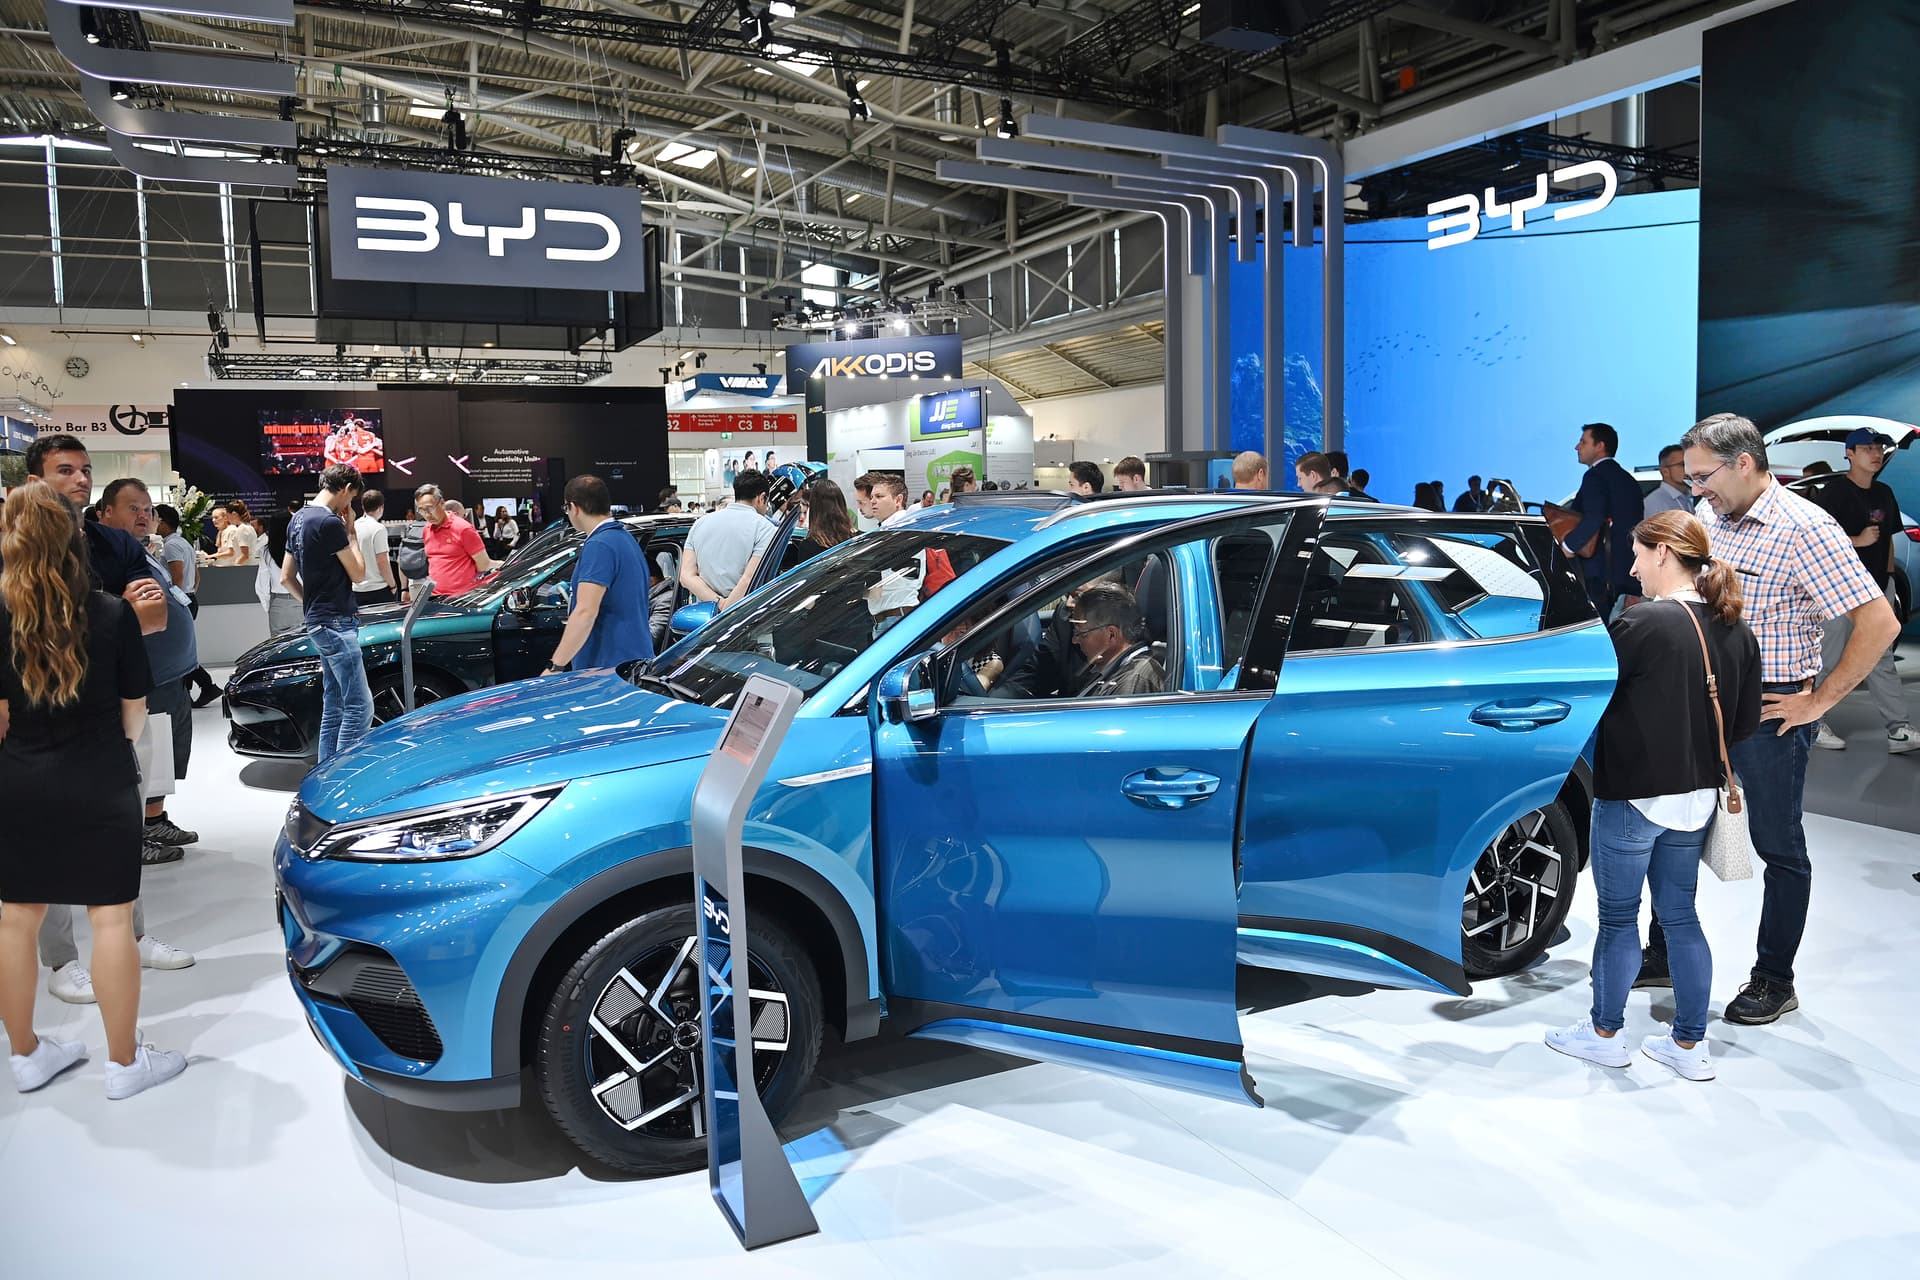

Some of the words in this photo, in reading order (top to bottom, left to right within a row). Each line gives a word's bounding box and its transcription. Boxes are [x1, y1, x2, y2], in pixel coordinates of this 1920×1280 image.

[1427, 159, 1618, 250] BYD
[355, 196, 621, 262] BYD
[31, 423, 61, 432] istro
[66, 423, 87, 432] Bar
[91, 423, 107, 432] B3
[738, 420, 753, 430] C3
[763, 420, 778, 430] B4
[703, 895, 730, 935] BYD
